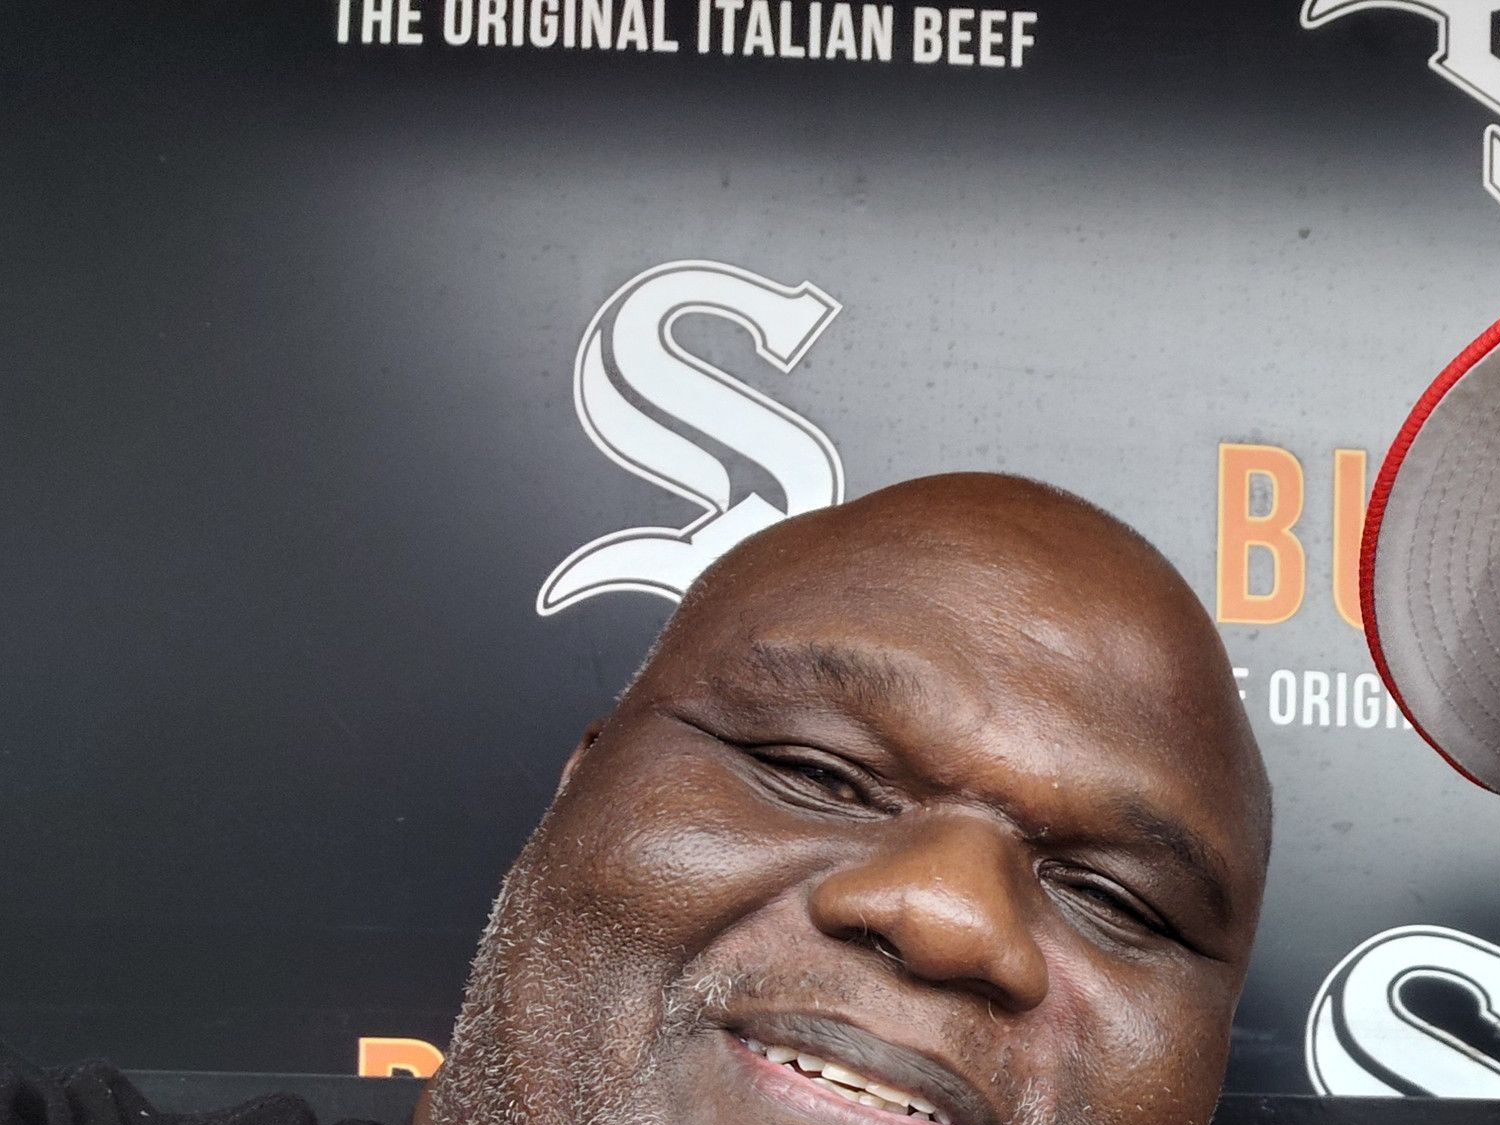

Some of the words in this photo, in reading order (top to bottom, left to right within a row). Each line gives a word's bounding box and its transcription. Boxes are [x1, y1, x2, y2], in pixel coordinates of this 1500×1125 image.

[337, 0, 423, 44] THE
[443, 0, 679, 52] ORIGINAL
[698, 0, 894, 62] ITALIAN
[913, 6, 1037, 68] BEEF
[1268, 669, 1414, 730] ORIGI
